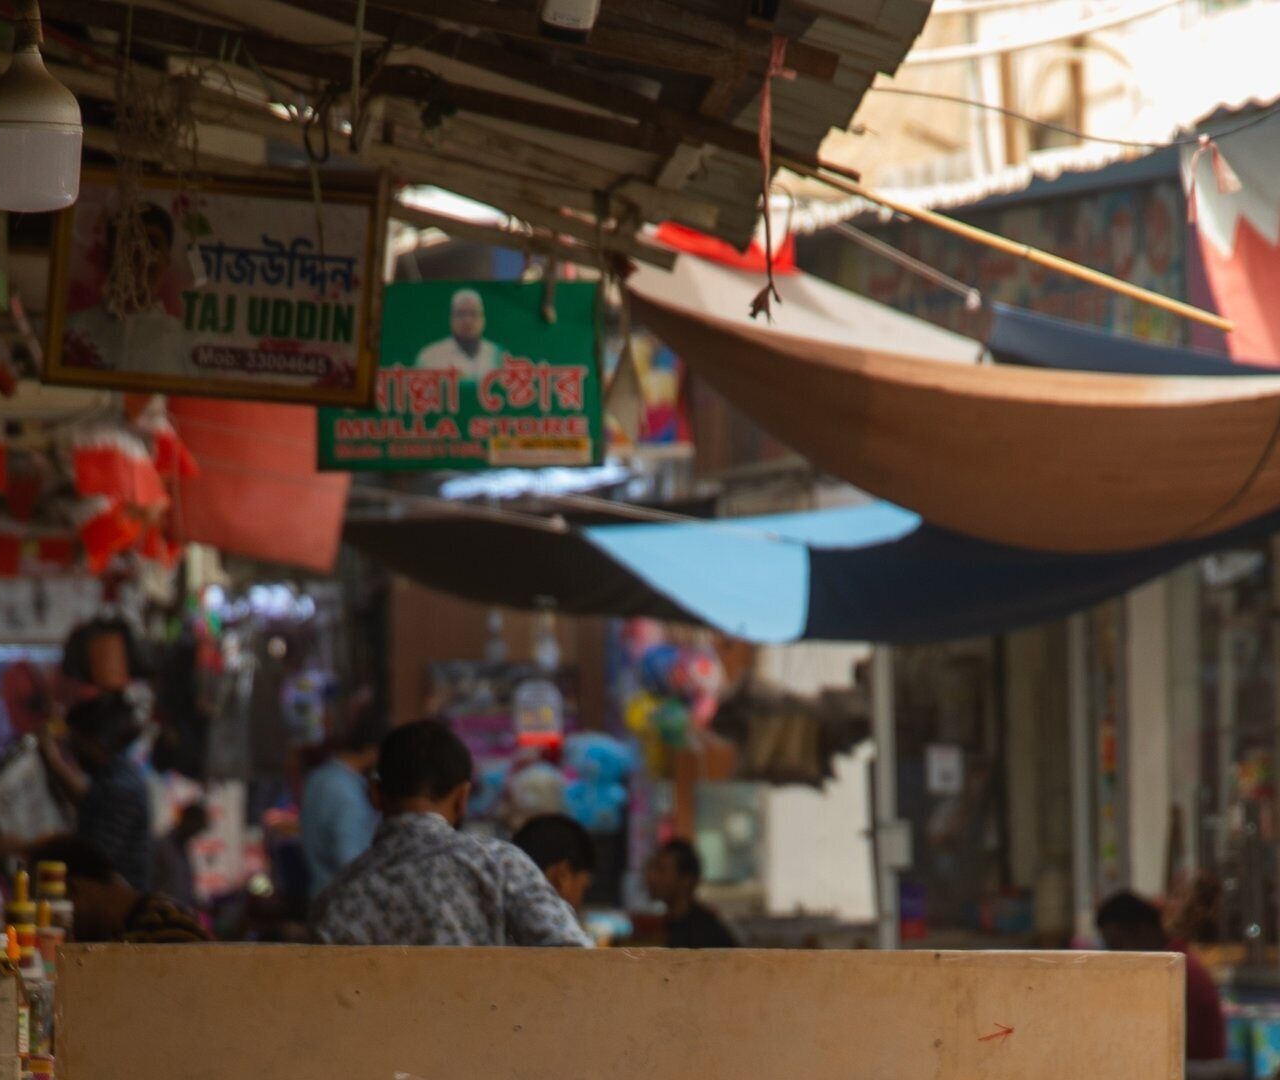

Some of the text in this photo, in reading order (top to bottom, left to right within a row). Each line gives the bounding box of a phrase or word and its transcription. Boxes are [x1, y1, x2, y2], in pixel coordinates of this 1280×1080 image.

[182, 290, 355, 343] TAJ UDDIN
[334, 415, 589, 439] MULLA STORE
